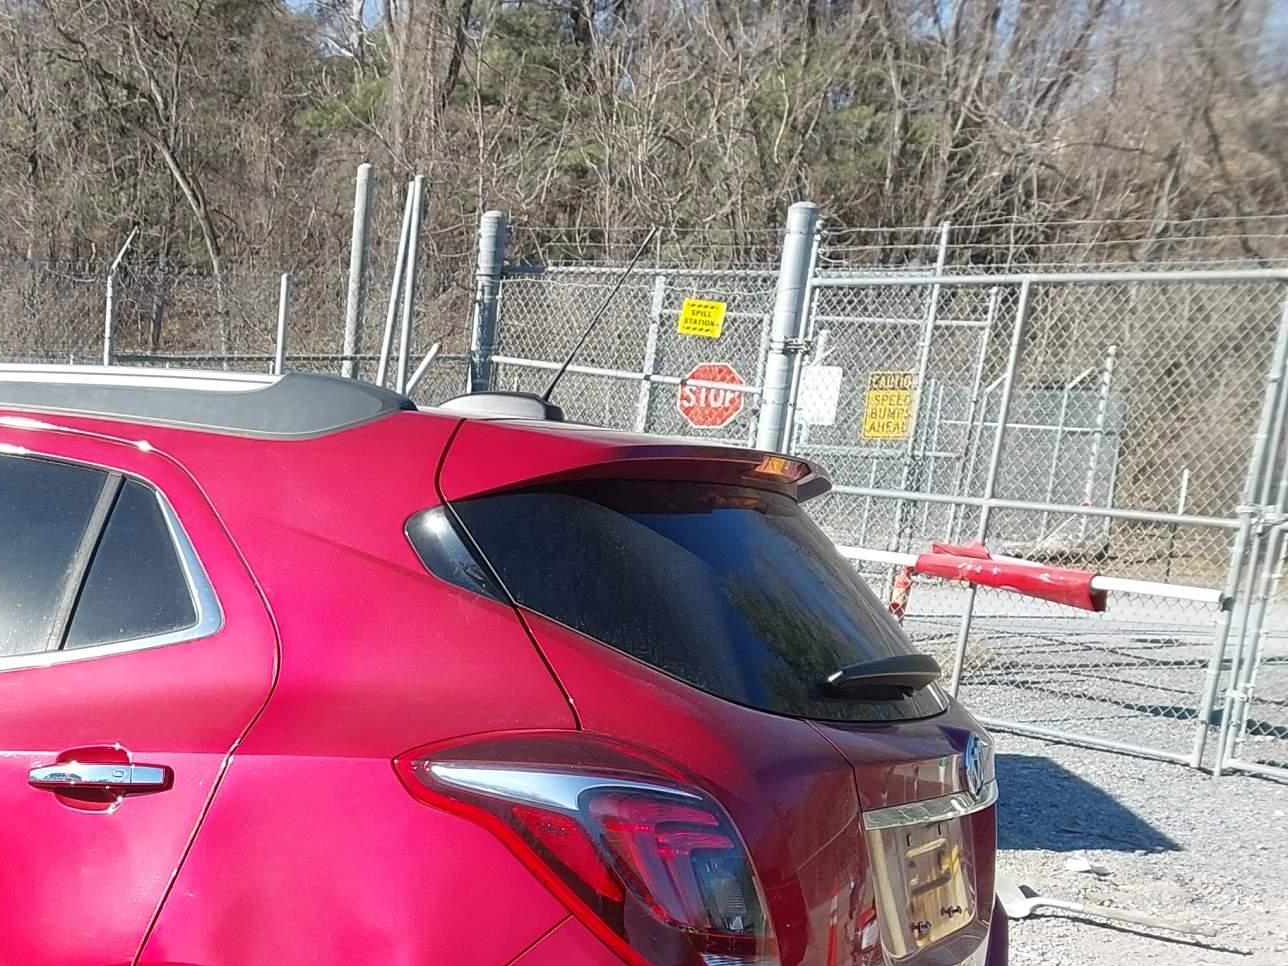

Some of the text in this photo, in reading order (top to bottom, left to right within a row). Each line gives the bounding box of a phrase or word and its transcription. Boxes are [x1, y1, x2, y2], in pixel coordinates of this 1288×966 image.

[691, 309, 712, 318] SPILL
[684, 318, 715, 327] STATION
[682, 386, 739, 408] STOP
